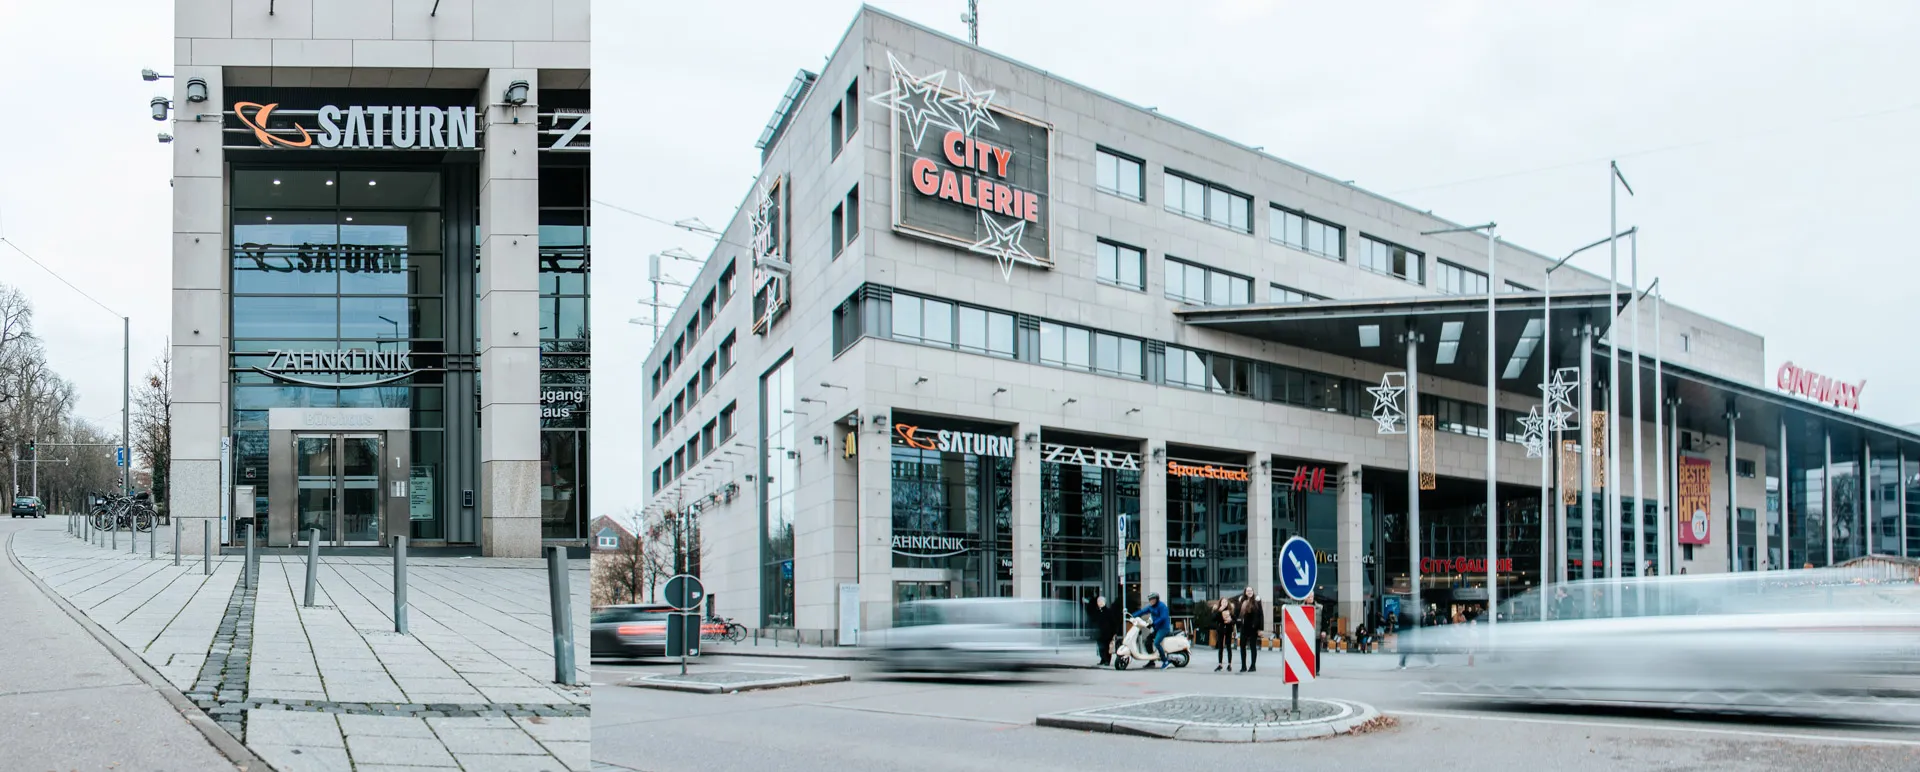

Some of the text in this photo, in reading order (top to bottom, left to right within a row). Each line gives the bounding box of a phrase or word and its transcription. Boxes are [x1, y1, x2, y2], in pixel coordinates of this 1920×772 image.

[317, 104, 476, 149] SATURN
[943, 129, 1012, 178] CITY
[912, 157, 1039, 224] GALERIE
[267, 348, 412, 372] ZAHNKLINIK
[1777, 361, 1867, 411] CINEMAXX
[937, 429, 1014, 458] SATURN
[1044, 444, 1139, 472] ZARA
[1167, 461, 1249, 482] SportScheck
[1680, 464, 1711, 484] BESTEN
[891, 534, 965, 551] AHNKLINIK
